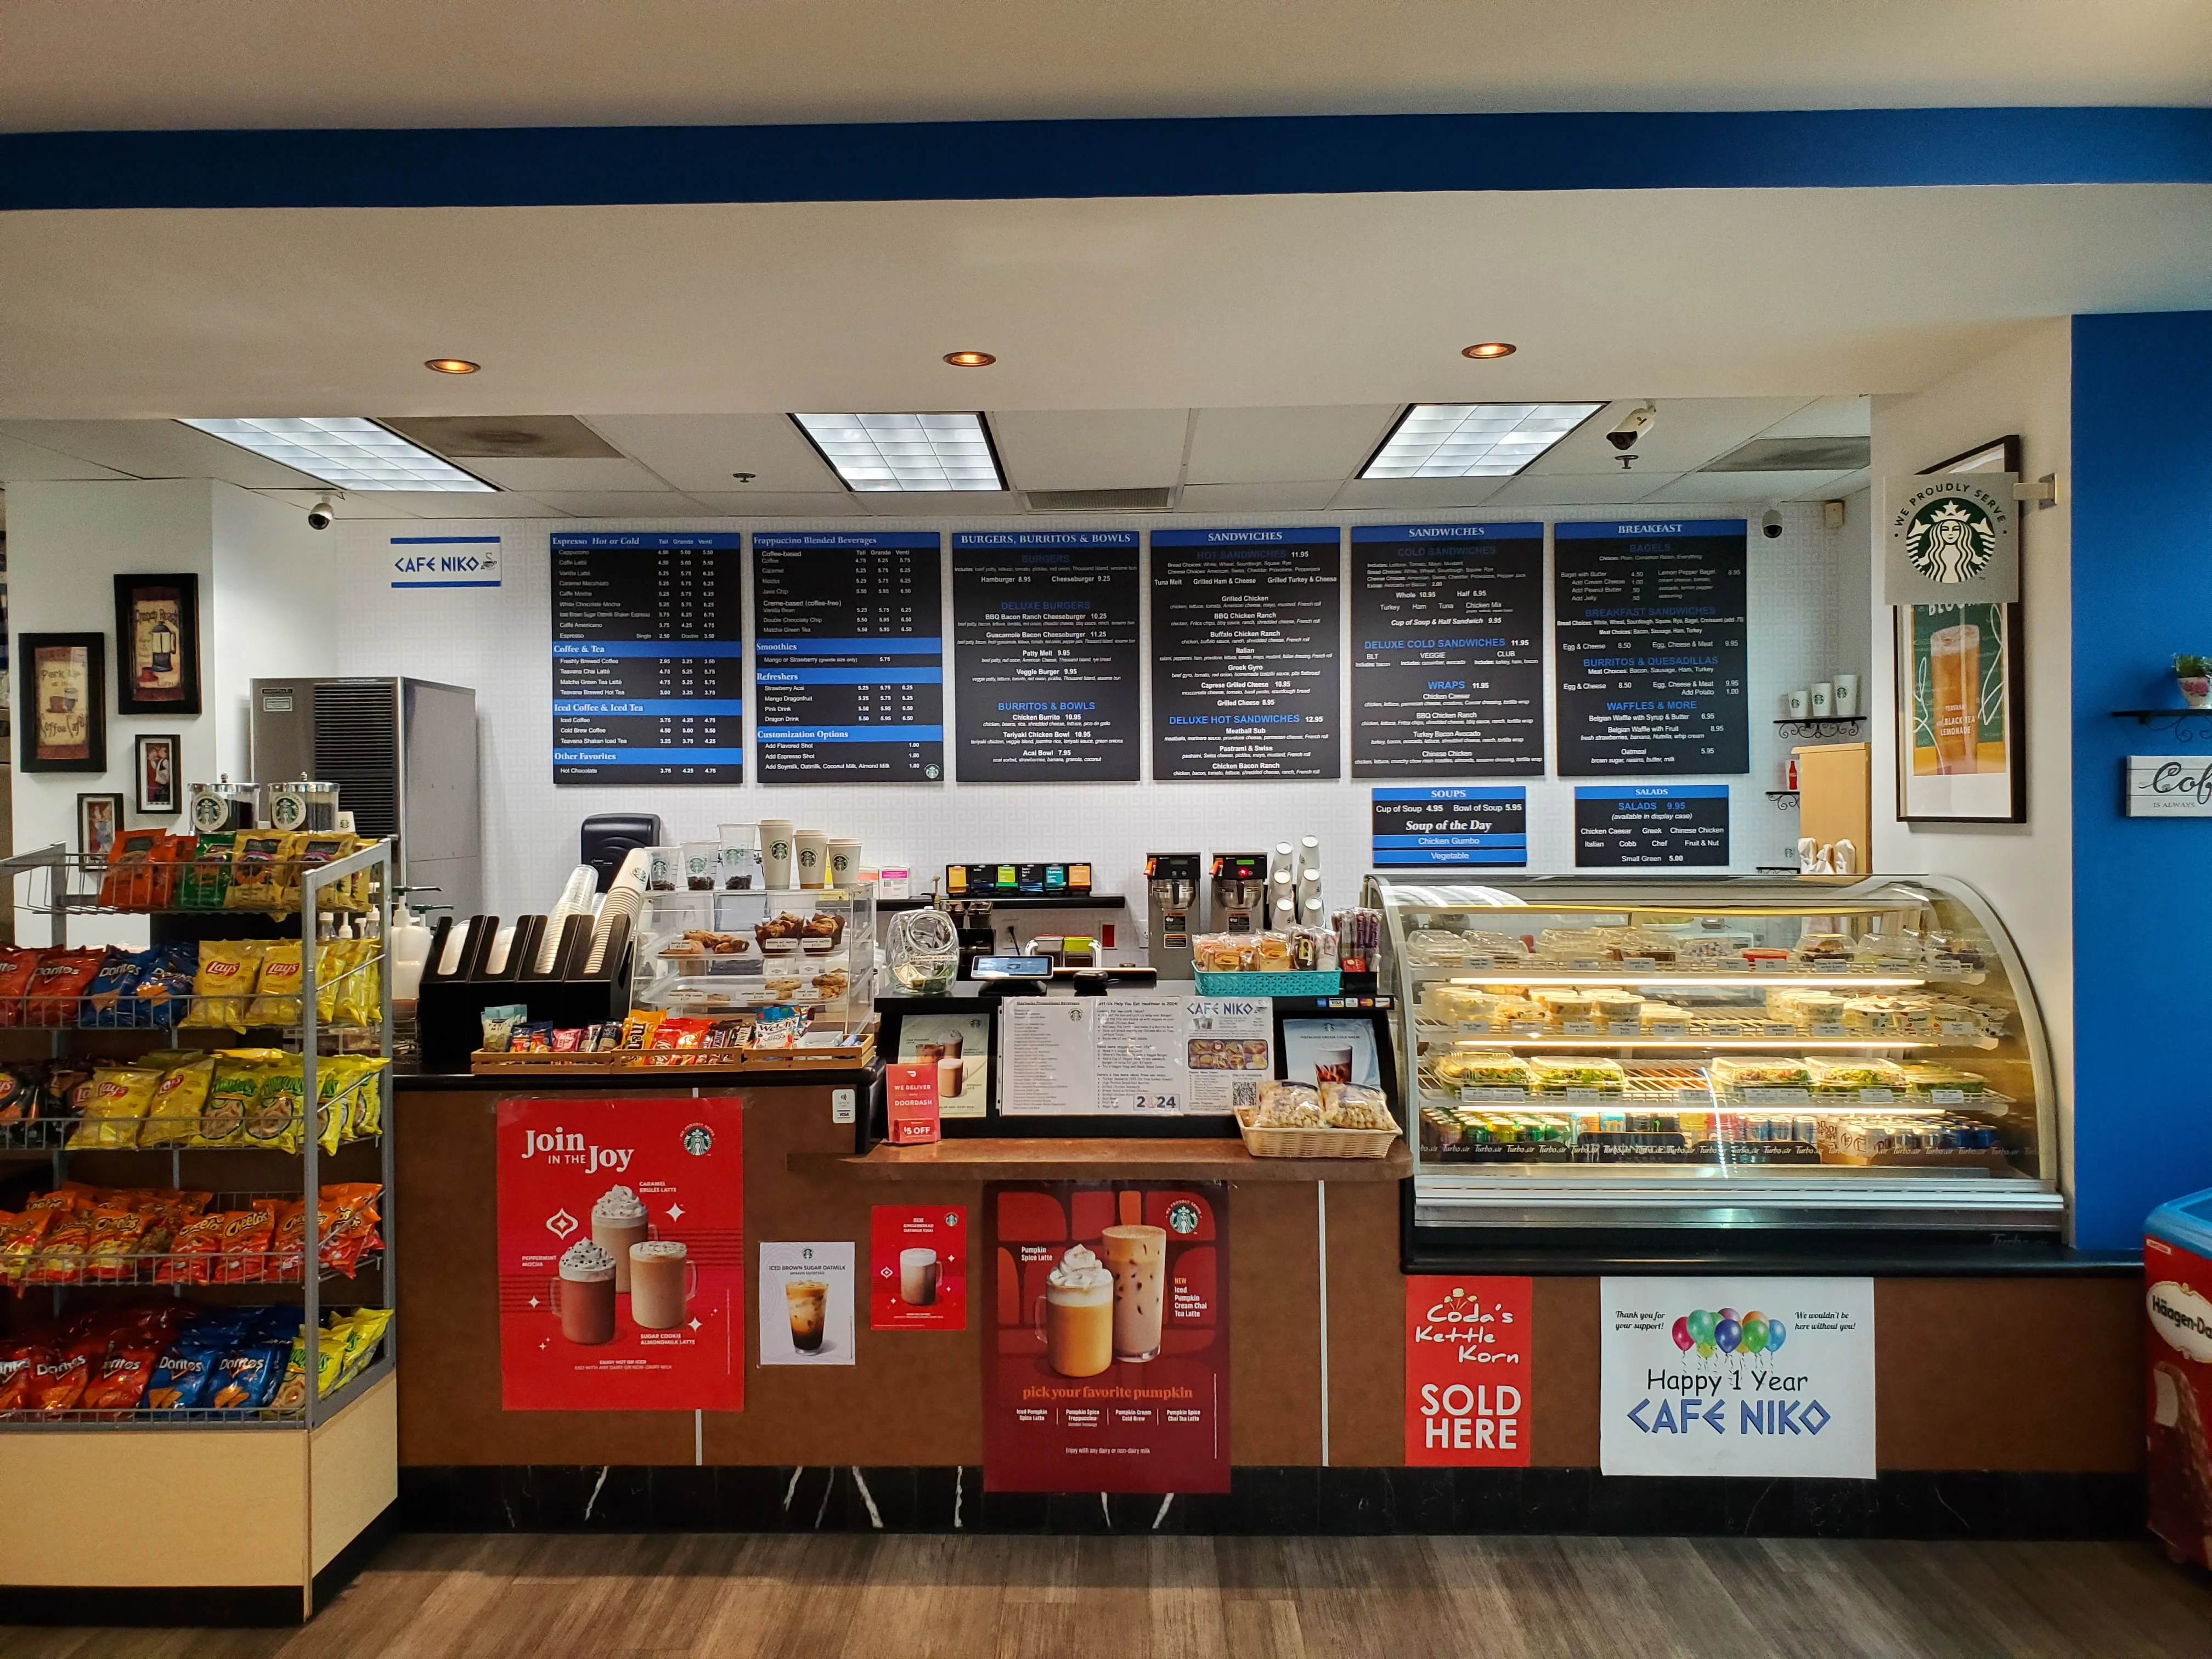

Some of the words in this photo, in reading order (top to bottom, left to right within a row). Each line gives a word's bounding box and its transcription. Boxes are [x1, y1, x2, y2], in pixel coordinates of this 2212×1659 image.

[1894, 508, 1909, 526] WE
[1910, 483, 1970, 506] PROUDLY
[1974, 489, 2006, 523] SERVE
[1409, 527, 1485, 537] SANDWICHES
[1618, 524, 1683, 533] BREAKFAST
[961, 535, 1017, 544] BURGERS,
[1208, 532, 1282, 541] SANDWICHES
[553, 538, 588, 547] Espresso
[442, 556, 479, 572] NIKO
[1428, 681, 1465, 690] WRAPS
[998, 702, 1047, 710] BURRITOS
[1607, 702, 1654, 710] WAFFLES
[1667, 701, 1697, 709] MORE
[1169, 716, 1208, 725] DELUXE
[1234, 715, 1299, 723] SANDWICHES
[1944, 717, 1962, 725] BLACK
[817, 731, 848, 740] Options
[1940, 726, 1971, 736] LEMONADE
[1431, 789, 1466, 798] SOUPS
[1406, 821, 1433, 833] Soup
[1436, 820, 1449, 830] of
[1450, 821, 1468, 830] the
[1470, 820, 1492, 832] Day
[1431, 852, 1470, 860] Vegetable
[99, 963, 142, 977] Doritos
[207, 962, 240, 976] Lay's
[267, 962, 300, 975] Lay's
[1223, 1002, 1253, 1014] NIKO
[522, 1127, 585, 1158] Join
[548, 1155, 562, 1164] IN
[565, 1154, 586, 1164] THE
[585, 1146, 635, 1173] Joy
[224, 1212, 268, 1237] Cheetos
[1022, 1246, 1046, 1255] Pumpkin
[1175, 1294, 1200, 1302] Pumpkin
[1426, 1303, 1513, 1323] Coda's
[1616, 1311, 1638, 1319] Thank
[1640, 1313, 1653, 1321] you
[1654, 1311, 1666, 1321] for
[1795, 1311, 1807, 1319] We
[1808, 1311, 1839, 1319] wouldn't
[1841, 1311, 1849, 1319] be
[1615, 1323, 1632, 1331] your
[1634, 1322, 1664, 1331] support!
[1795, 1322, 1809, 1330] here
[1839, 1322, 1855, 1331] you!
[1415, 1325, 1496, 1343] Kettle
[1459, 1345, 1519, 1364] Korn
[36, 1355, 86, 1376] Doritos
[159, 1356, 203, 1372] Doritos
[219, 1357, 264, 1370] Doritos
[1647, 1368, 1722, 1397] Happy
[1732, 1369, 1741, 1390] 1
[1751, 1370, 1808, 1392] Year
[1023, 1386, 1049, 1400] pick
[1051, 1389, 1081, 1400] your
[1082, 1386, 1131, 1398] favorite
[1133, 1386, 1193, 1400] pumpkin
[1420, 1384, 1521, 1415] SOLD
[1741, 1399, 1831, 1435] NIKO
[1426, 1418, 1516, 1449] HERE
